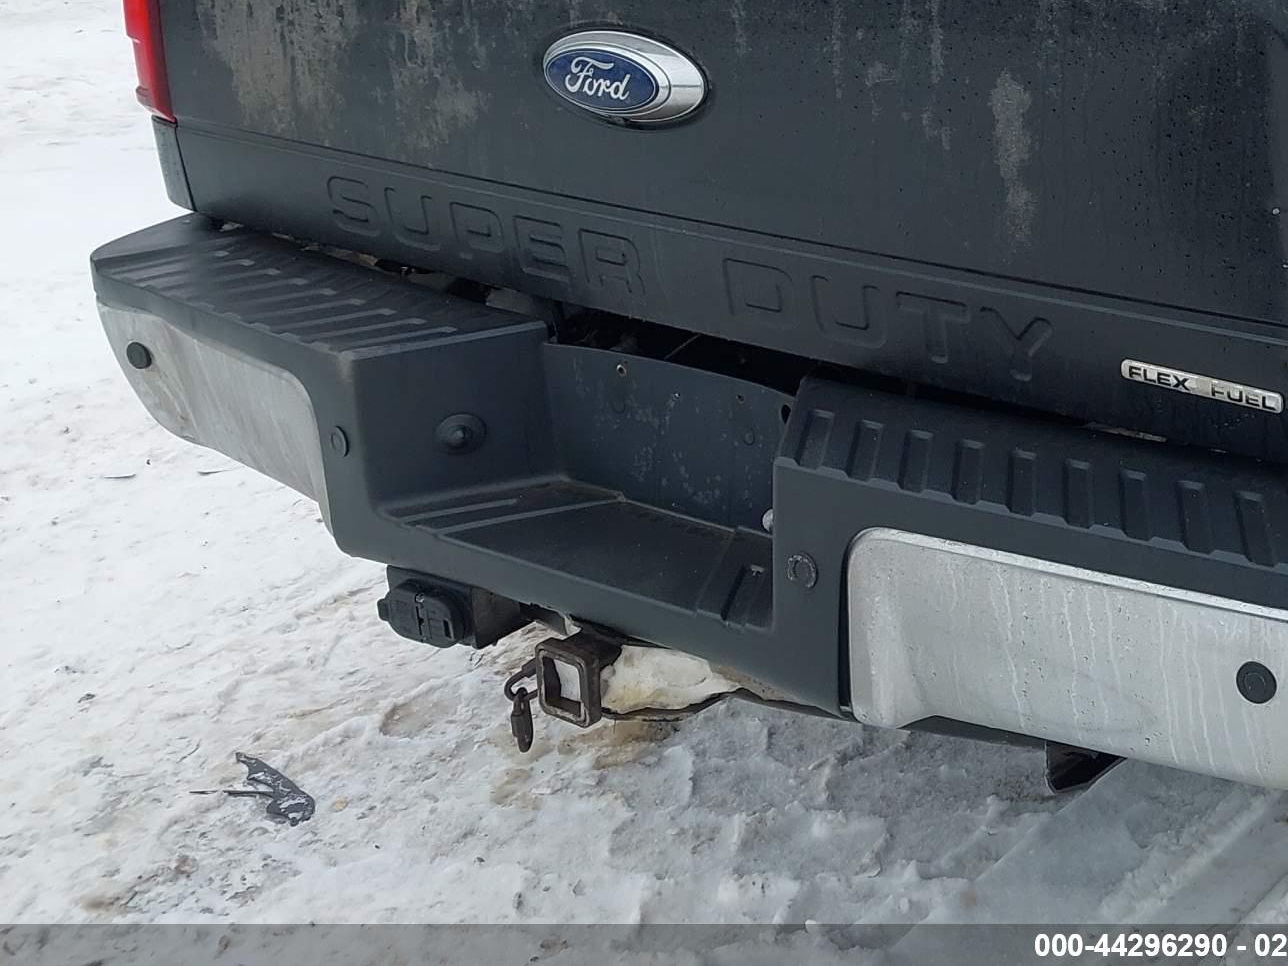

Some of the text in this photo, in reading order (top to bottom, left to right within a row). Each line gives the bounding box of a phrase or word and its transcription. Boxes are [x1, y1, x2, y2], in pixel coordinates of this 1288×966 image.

[564, 56, 632, 101] Ford
[326, 175, 1055, 382] SUPER DUTY
[1127, 364, 1277, 411] FLEX FUEL
